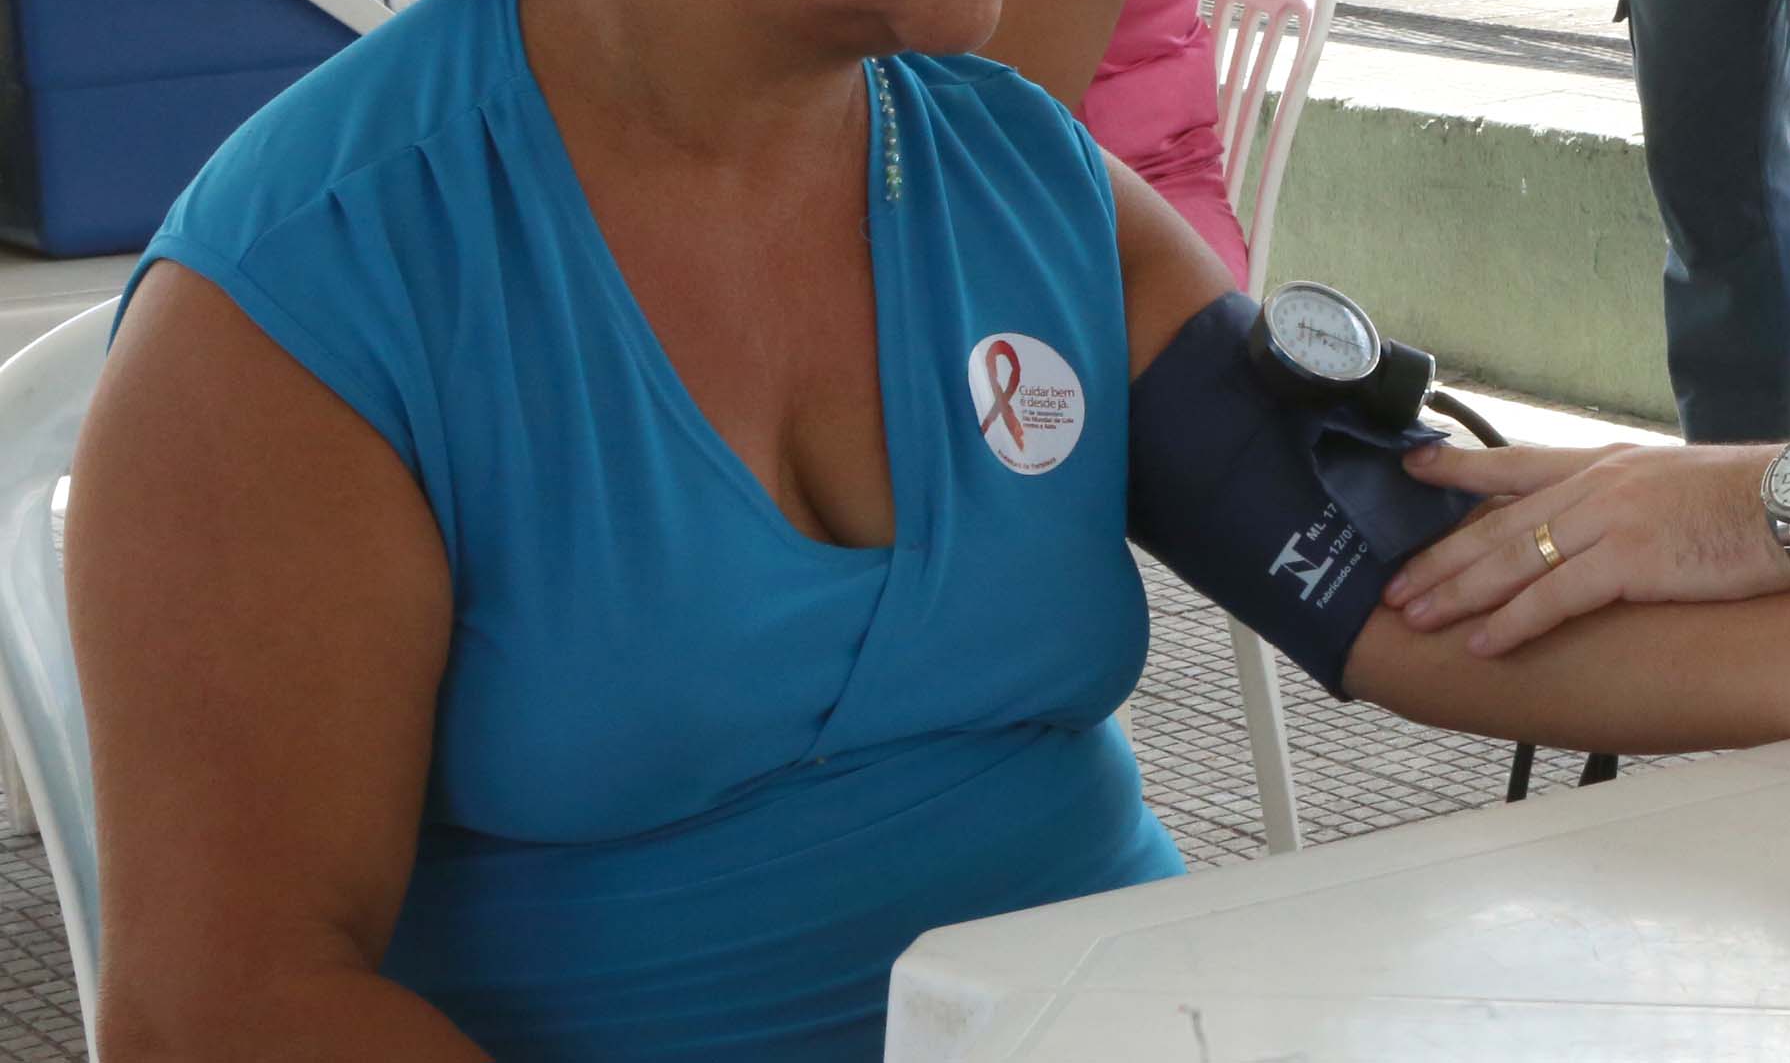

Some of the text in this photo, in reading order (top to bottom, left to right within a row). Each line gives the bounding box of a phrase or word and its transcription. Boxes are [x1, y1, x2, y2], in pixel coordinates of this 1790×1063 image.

[1019, 385, 1075, 398] Cuidar bem
[1025, 399, 1056, 409] desde
[1306, 523, 1327, 542] ML
[1316, 566, 1351, 609] Fabricado
